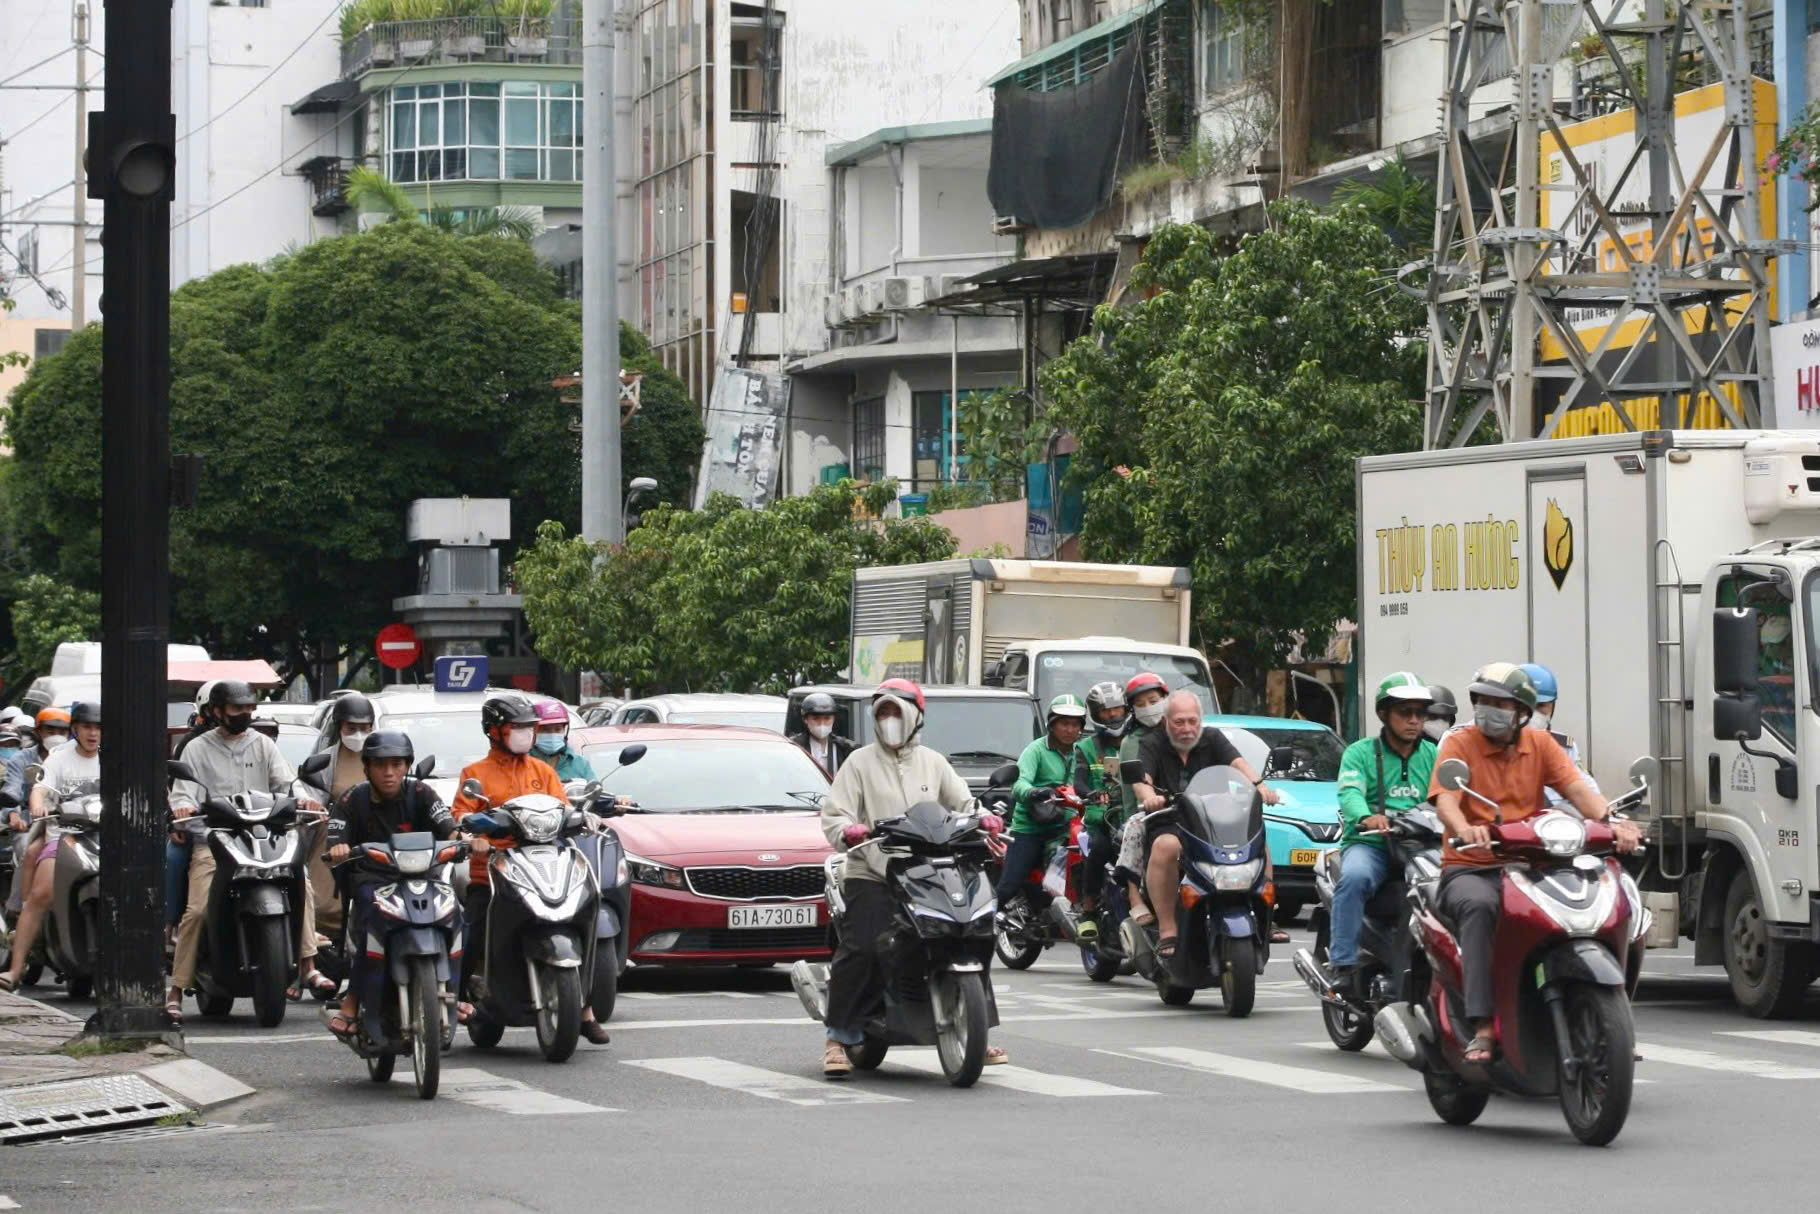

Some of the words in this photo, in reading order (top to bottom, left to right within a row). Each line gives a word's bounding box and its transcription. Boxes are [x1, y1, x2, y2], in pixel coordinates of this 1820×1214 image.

[1376, 516, 1426, 594] THÙY
[1464, 513, 1519, 591] HƯNG
[448, 660, 476, 688] G7
[1388, 784, 1420, 798] Grab
[1778, 838, 1799, 847] 210
[1296, 852, 1317, 863] 60H
[731, 907, 812, 926] 61A-730.61
